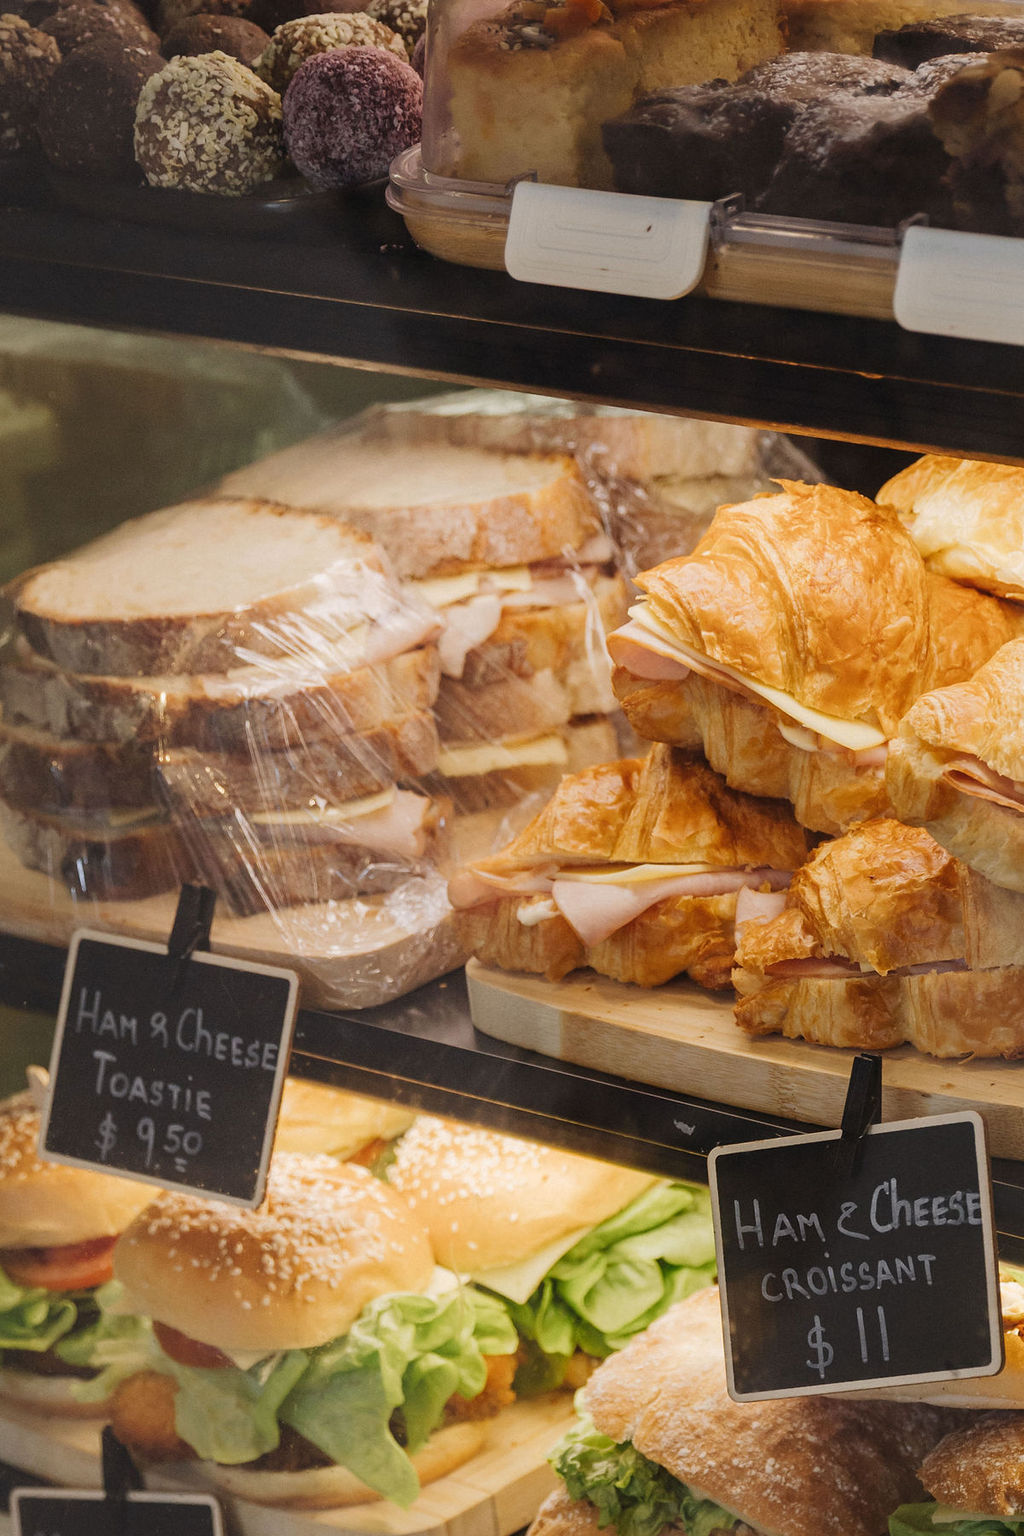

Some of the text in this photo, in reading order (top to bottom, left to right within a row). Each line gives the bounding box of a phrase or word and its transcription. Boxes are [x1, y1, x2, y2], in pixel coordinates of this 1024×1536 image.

[95, 1112, 117, 1161] $
[734, 1199, 826, 1250] HAM
[806, 1305, 890, 1379] $ 11
